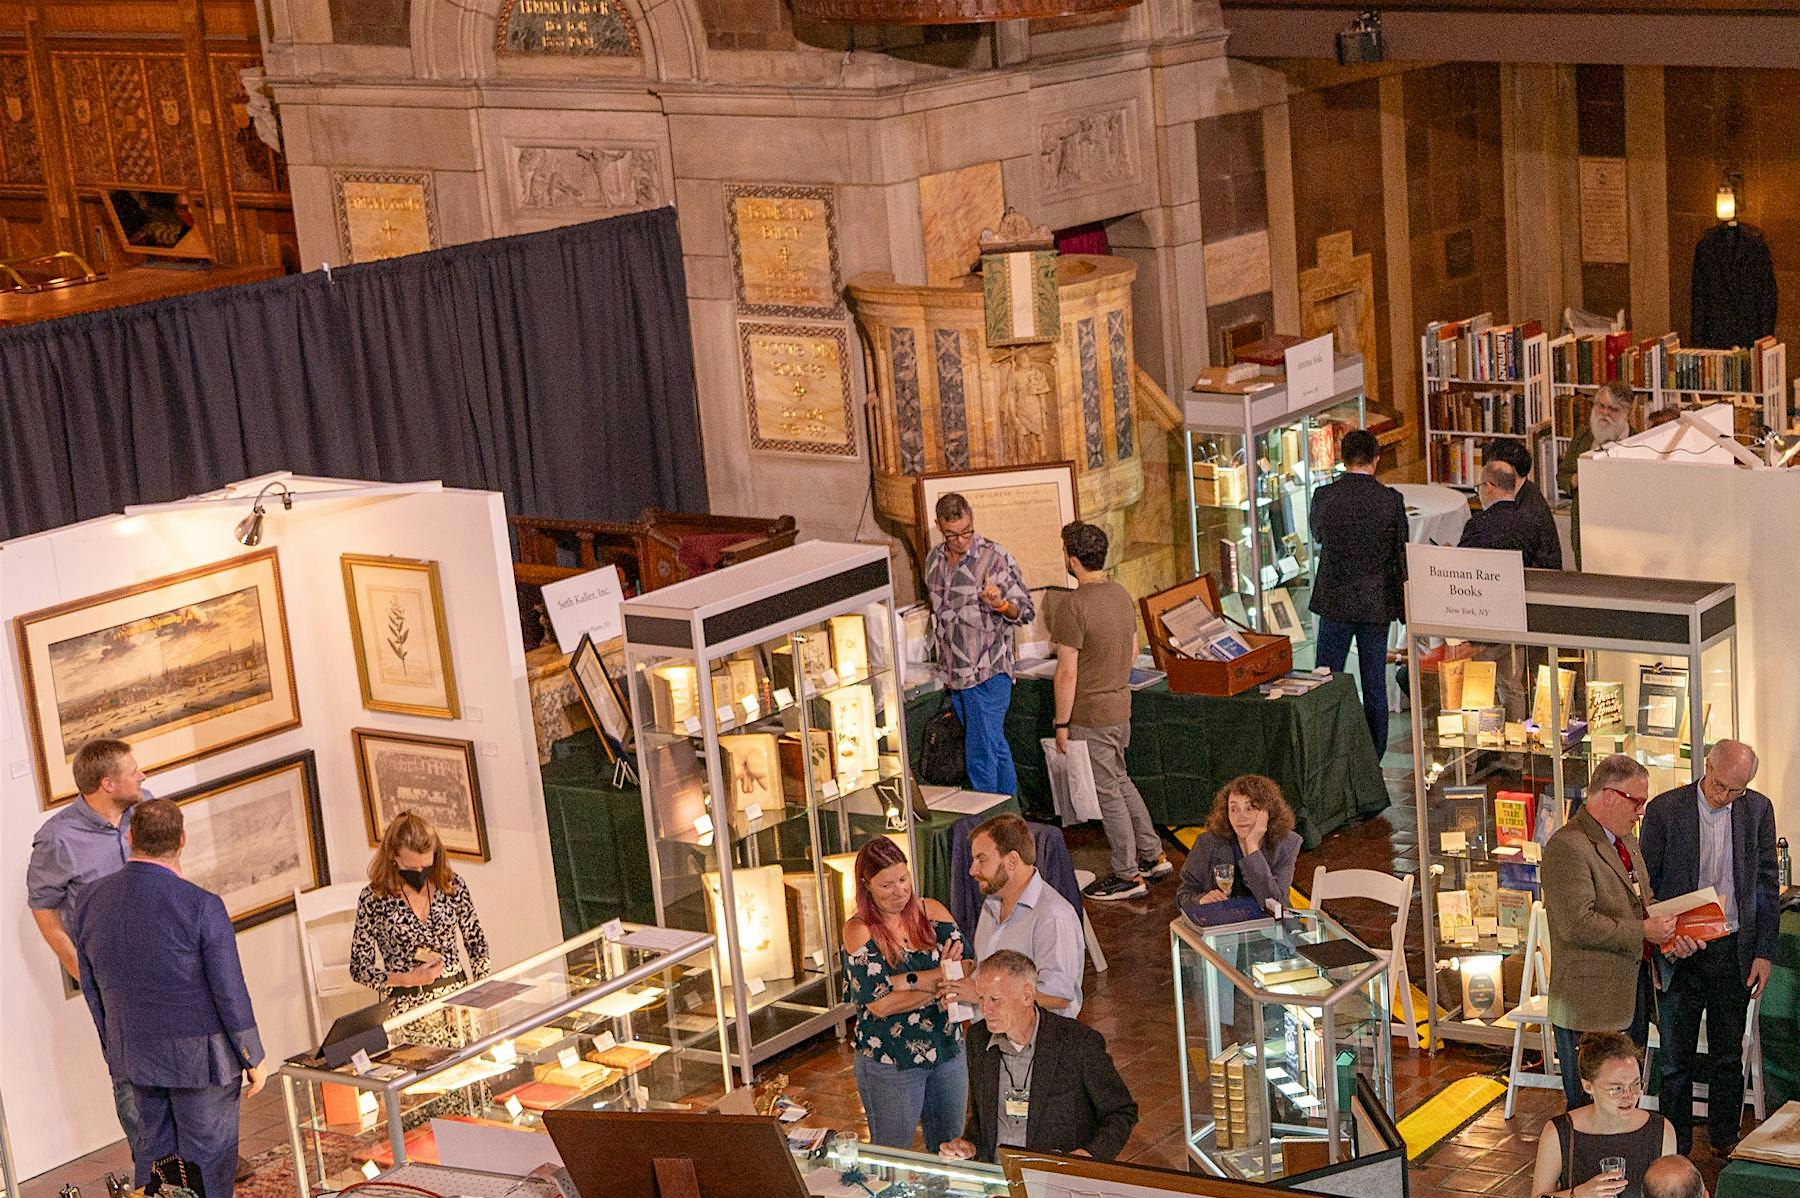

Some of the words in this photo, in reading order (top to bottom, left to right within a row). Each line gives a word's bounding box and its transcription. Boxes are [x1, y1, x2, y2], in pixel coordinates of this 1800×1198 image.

[1429, 565, 1472, 580] Bauman
[1476, 569, 1501, 581] Rare
[1449, 585, 1483, 597] Books
